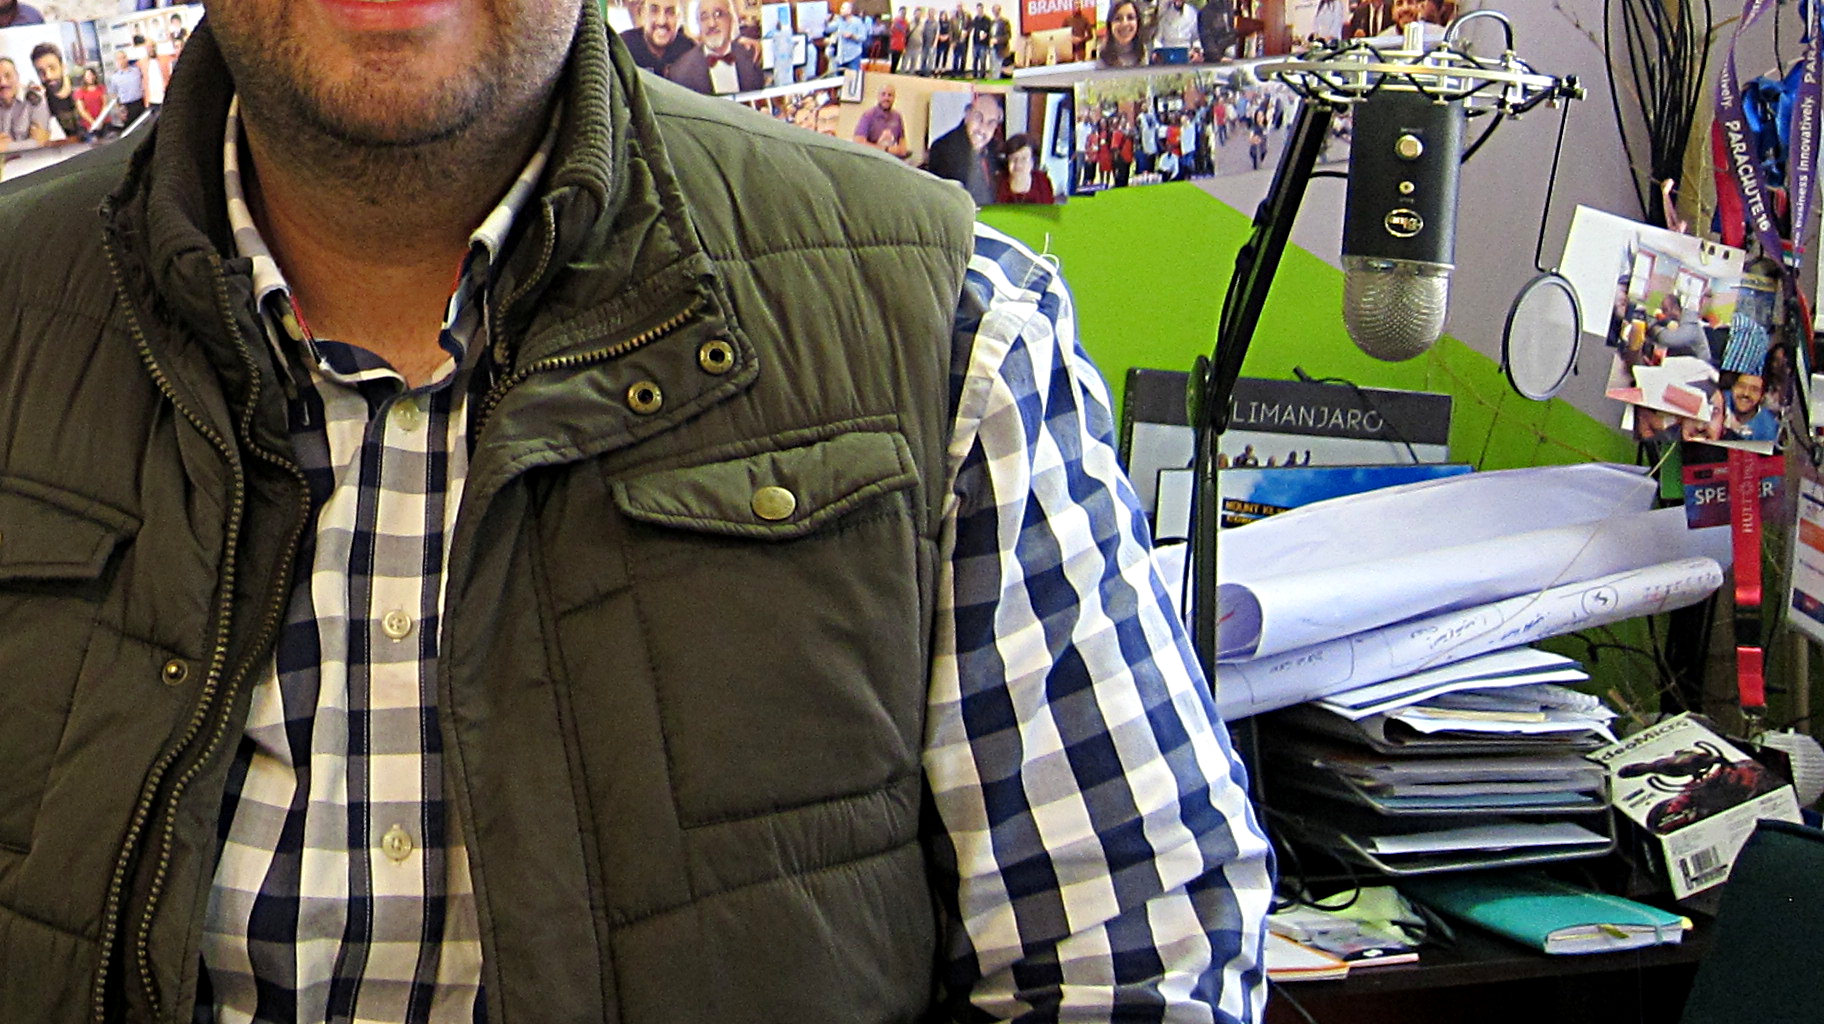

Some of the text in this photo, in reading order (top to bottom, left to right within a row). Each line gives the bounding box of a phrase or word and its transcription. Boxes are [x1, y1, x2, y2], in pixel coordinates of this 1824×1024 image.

[1725, 120, 1765, 216] PARACHUTE
[1232, 400, 1383, 433] LIMANJARO
[1694, 481, 1774, 506] SPER
[1601, 719, 1689, 761] deoMicro
